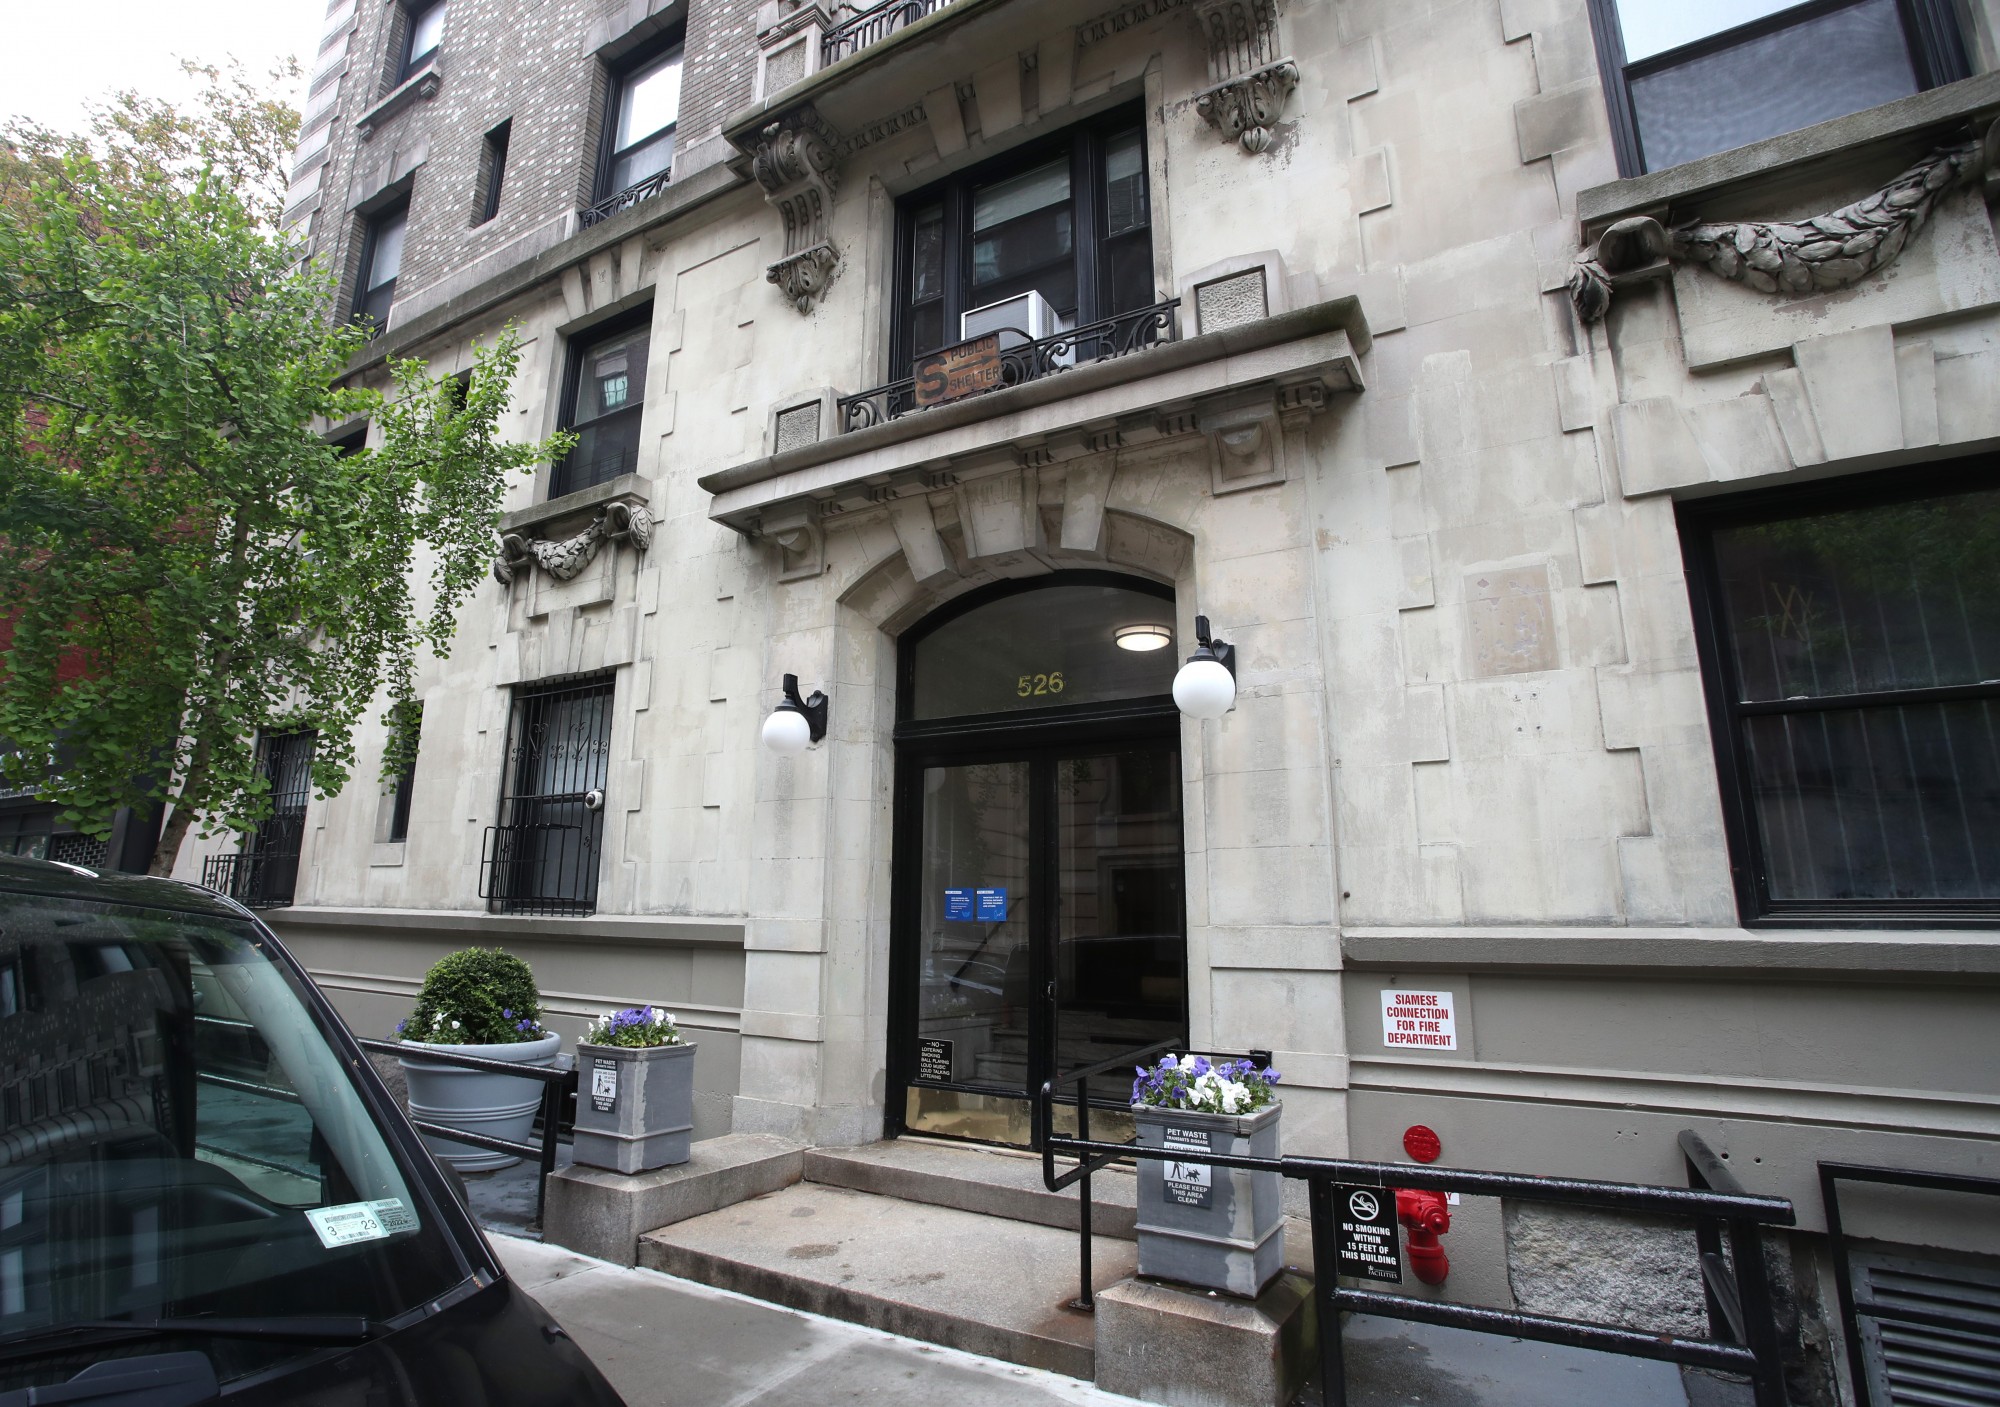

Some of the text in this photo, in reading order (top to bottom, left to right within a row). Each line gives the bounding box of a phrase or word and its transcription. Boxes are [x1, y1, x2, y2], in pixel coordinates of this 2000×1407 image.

[951, 338, 994, 361] PUBLIC
[917, 355, 949, 399] S
[949, 366, 1000, 391] SHELTER
[1017, 671, 1064, 697] 526
[1395, 994, 1438, 1006] SIAMESE
[1386, 1006, 1449, 1020] CONNECTION
[1396, 1019, 1441, 1032] FOR FIRE
[1387, 1032, 1452, 1046] DEPARTMENT
[921, 1046, 943, 1054] LOITERING
[932, 1068, 951, 1076] TALKING
[1166, 1135, 1190, 1143] TRANSMITS
[1167, 1128, 1208, 1139] PET WASTE
[1167, 1181, 1208, 1193] PLEASE KEEP
[1171, 1188, 1203, 1199] THIS AREA
[1177, 1196, 1198, 1205] CLEAN
[361, 1219, 378, 1230] 23
[1342, 1222, 1391, 1236] NO SMOKING
[327, 1225, 338, 1237] 3
[1353, 1232, 1381, 1244] WITHIN
[1347, 1241, 1389, 1255] 15 FEET OF
[1341, 1250, 1397, 1266] THIS BUILDING
[1368, 1269, 1398, 1279] FACILITIES
